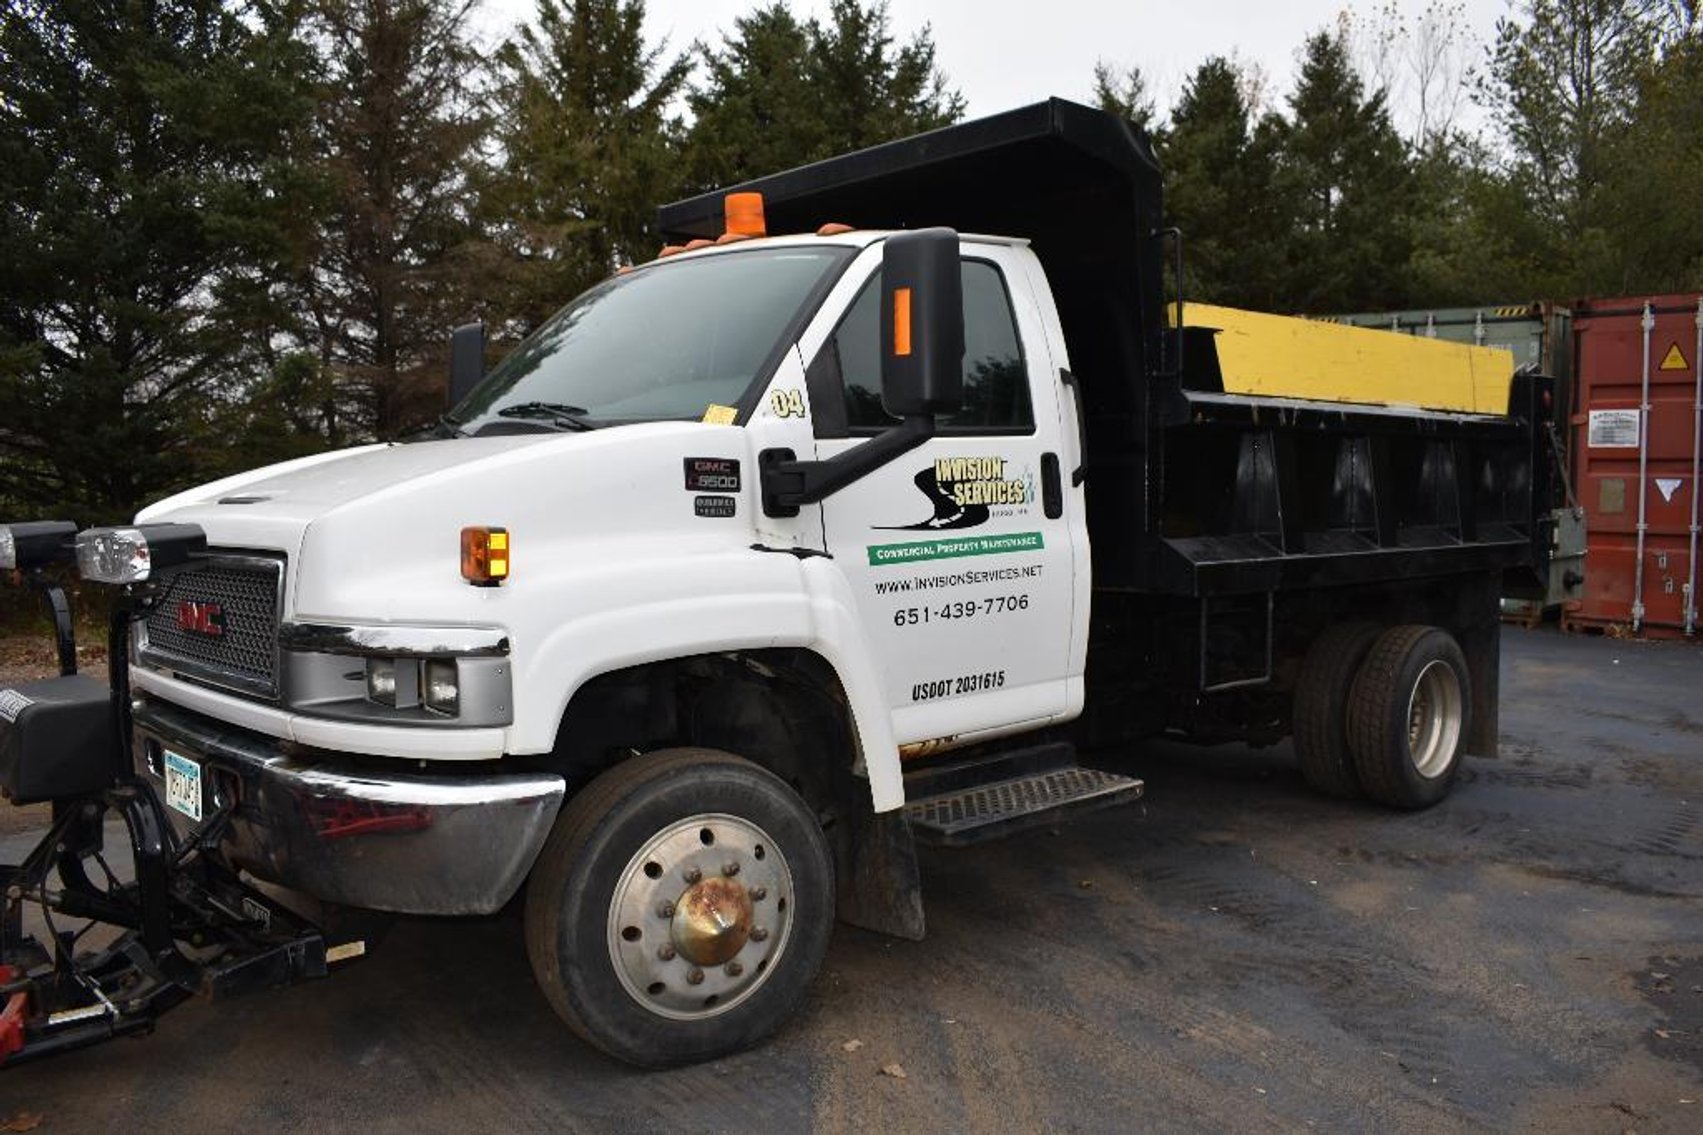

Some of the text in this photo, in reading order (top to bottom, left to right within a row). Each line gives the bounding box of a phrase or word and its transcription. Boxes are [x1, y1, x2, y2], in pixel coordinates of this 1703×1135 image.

[771, 389, 805, 418] 04
[694, 461, 731, 473] GMC
[935, 457, 1004, 481] INVISION
[953, 479, 1025, 506] SERVICES
[876, 536, 1038, 560] COMMERCIAL PROPERTY MAINTENANCE
[894, 595, 1030, 626] 651-439-7706
[912, 670, 1006, 701] USDOT 2031615
